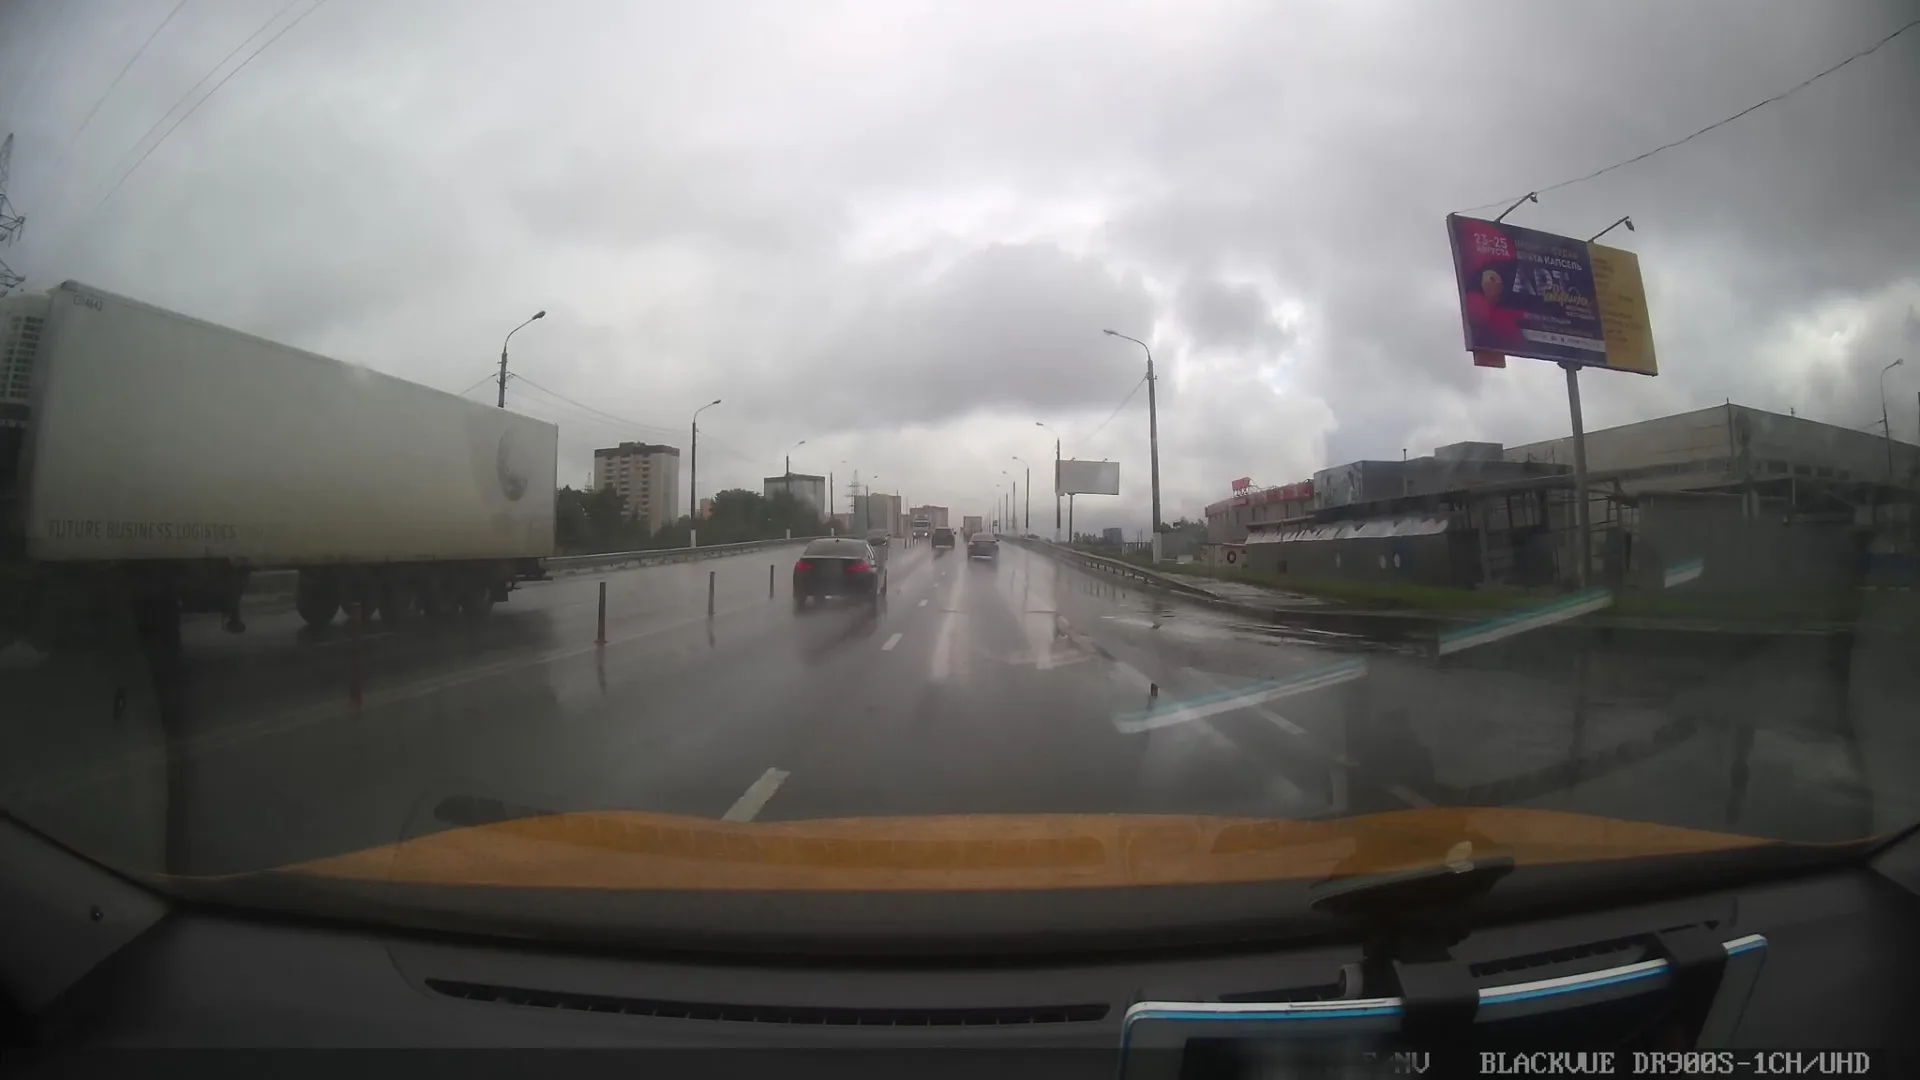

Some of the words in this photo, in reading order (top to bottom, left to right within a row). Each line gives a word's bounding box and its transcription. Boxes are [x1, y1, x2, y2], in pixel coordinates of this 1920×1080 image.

[1474, 232, 1508, 249] 23-25
[1544, 256, 1583, 271] КАПСЕЛЬ
[48, 519, 102, 539] FUTURE
[106, 520, 174, 540] BUSINESS
[176, 522, 239, 540] LOGISTICS
